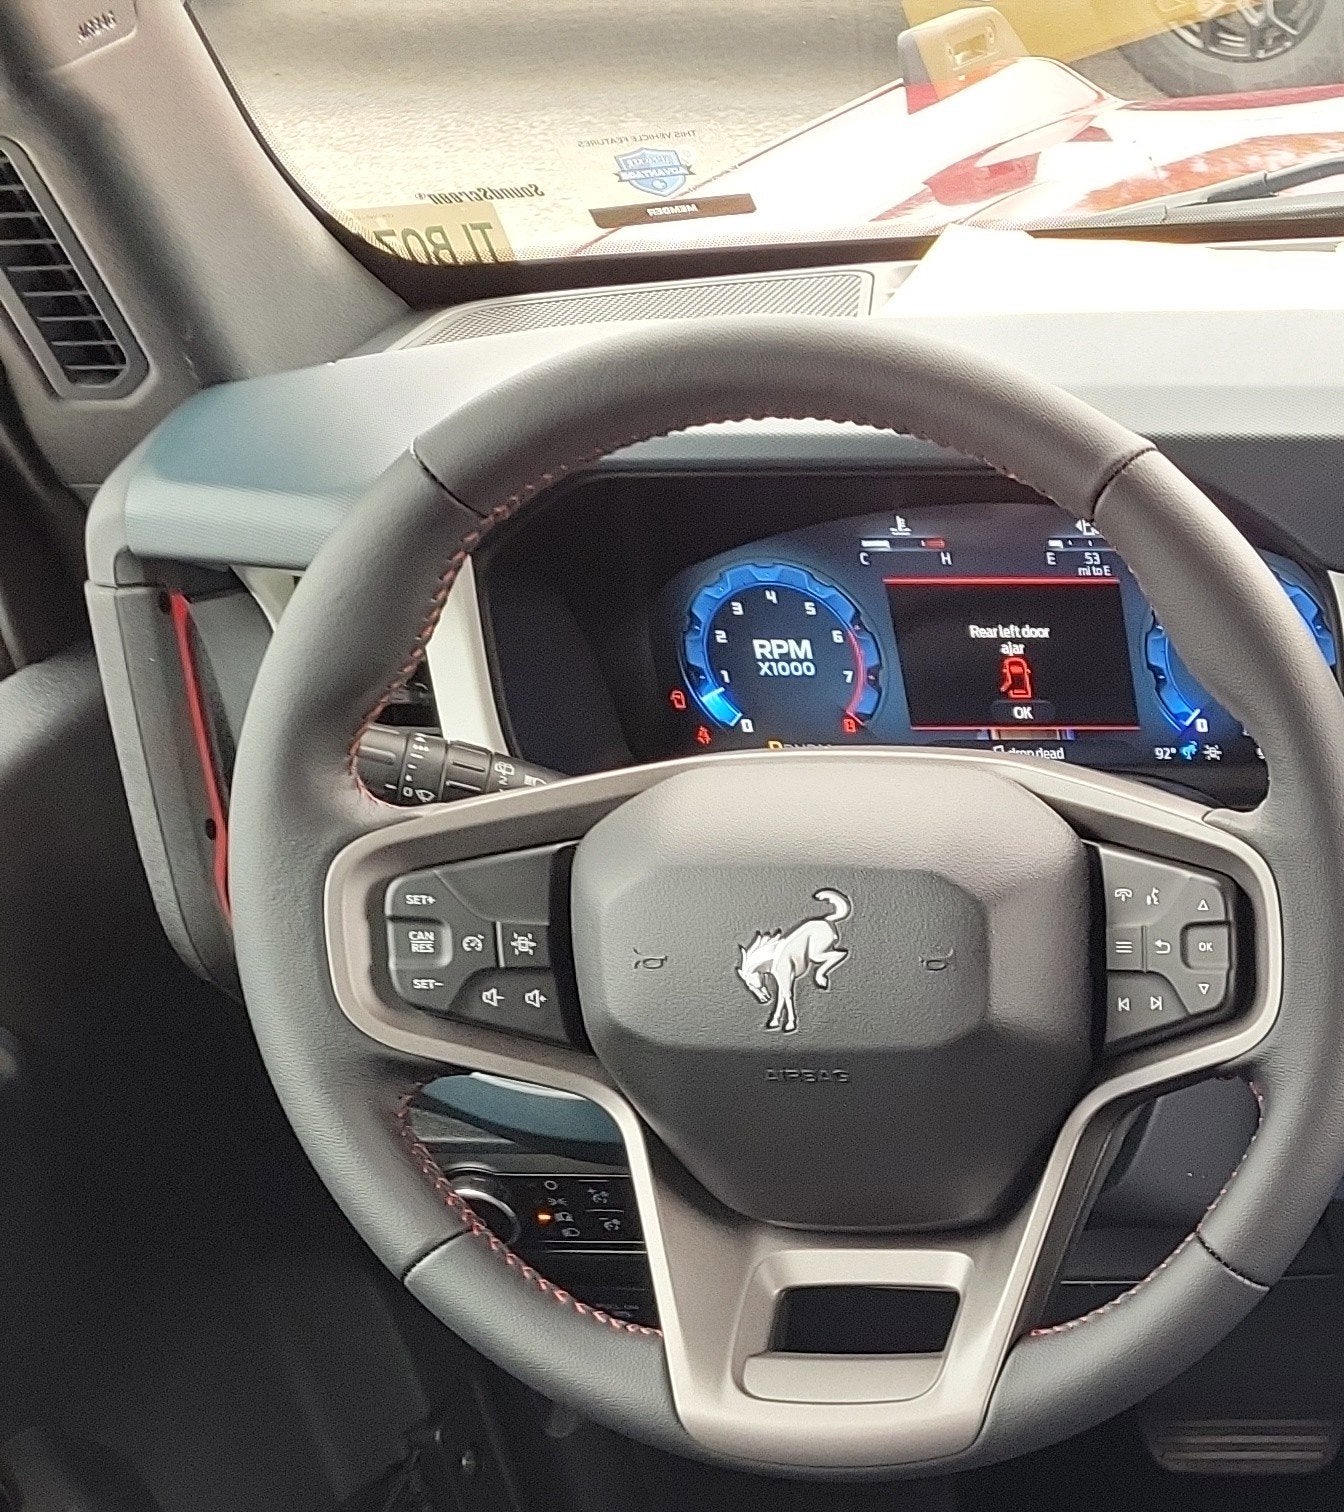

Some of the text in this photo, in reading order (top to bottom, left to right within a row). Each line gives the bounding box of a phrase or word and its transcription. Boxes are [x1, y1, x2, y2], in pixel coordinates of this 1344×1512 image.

[859, 552, 952, 566] C H
[1046, 552, 1101, 565] E 53
[765, 590, 778, 604] 4
[731, 602, 744, 615] 3
[804, 602, 817, 615] 5
[715, 630, 728, 643] 2
[831, 630, 844, 643] 6
[968, 624, 1050, 638] Rear left door
[752, 638, 814, 660] RPM
[1000, 641, 1025, 656] ajar
[757, 661, 816, 676] X1000
[720, 670, 730, 683] 1
[843, 670, 853, 683] 7
[1013, 706, 1033, 719] OK
[406, 894, 436, 905] SET+
[408, 931, 435, 941] CAN
[412, 942, 435, 953] RES
[1199, 942, 1213, 952] OK
